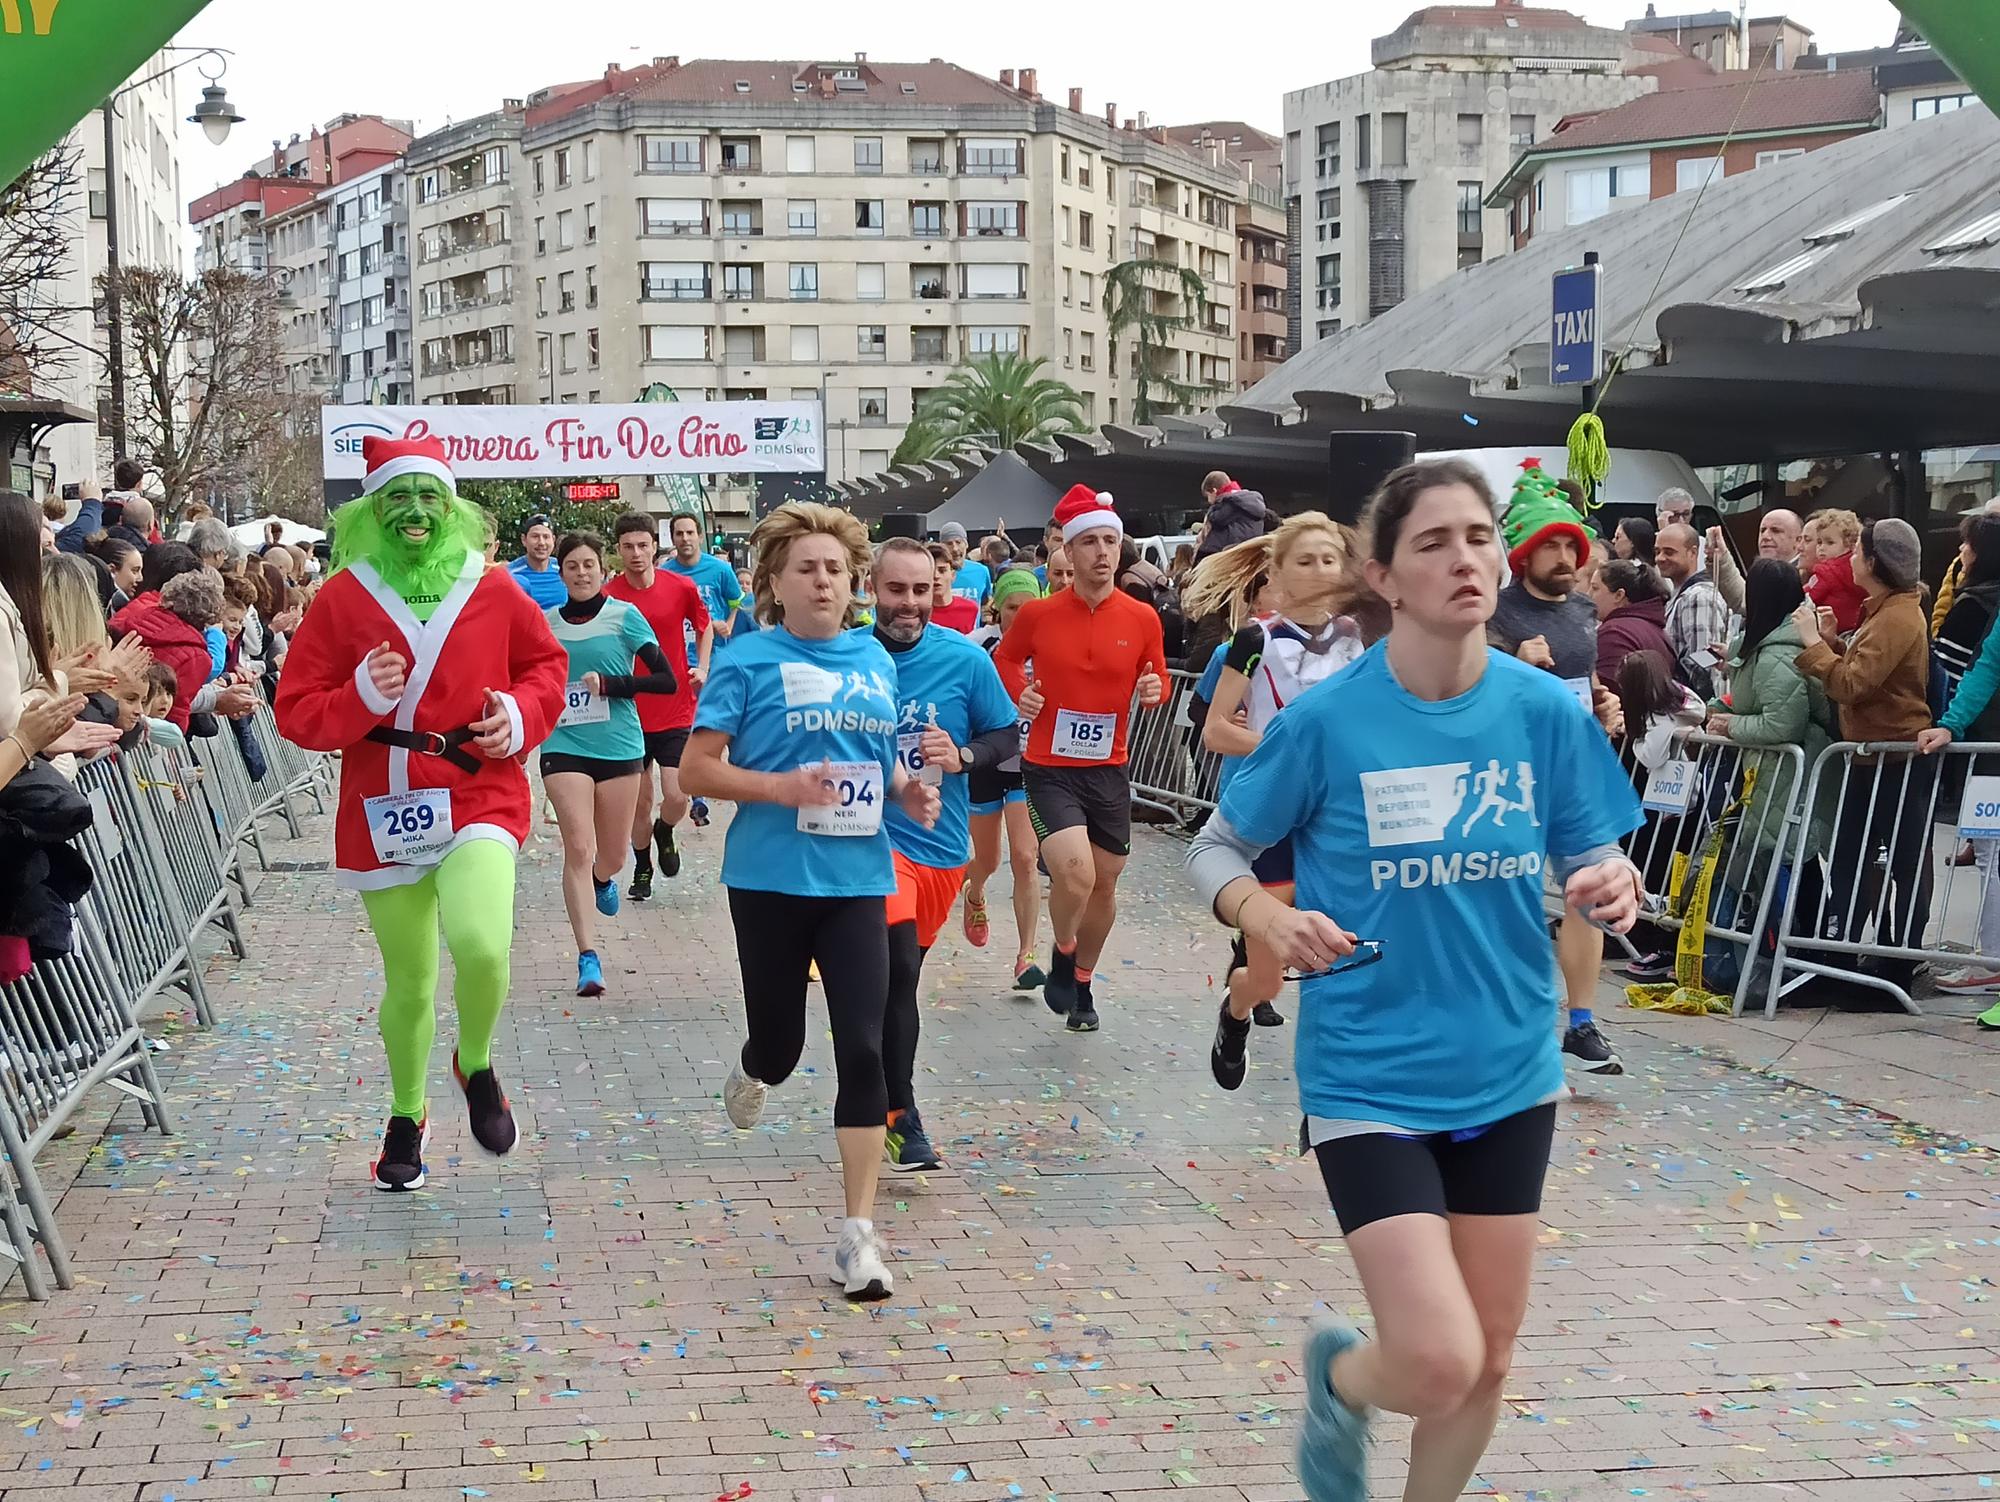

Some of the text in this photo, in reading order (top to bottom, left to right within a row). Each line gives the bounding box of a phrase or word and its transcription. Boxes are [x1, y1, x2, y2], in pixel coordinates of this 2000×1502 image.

[1555, 308, 1593, 346] TAXI
[545, 418, 611, 462] Fin
[617, 416, 672, 459] De
[569, 691, 592, 708] 87
[785, 708, 896, 736] PDMSiero
[1070, 721, 1104, 742] 185
[1653, 780, 1684, 796] sonar
[383, 804, 435, 836] 269
[834, 809, 857, 819] NERI
[402, 834, 425, 844] MIKA
[1370, 850, 1541, 891] PDMSiero
